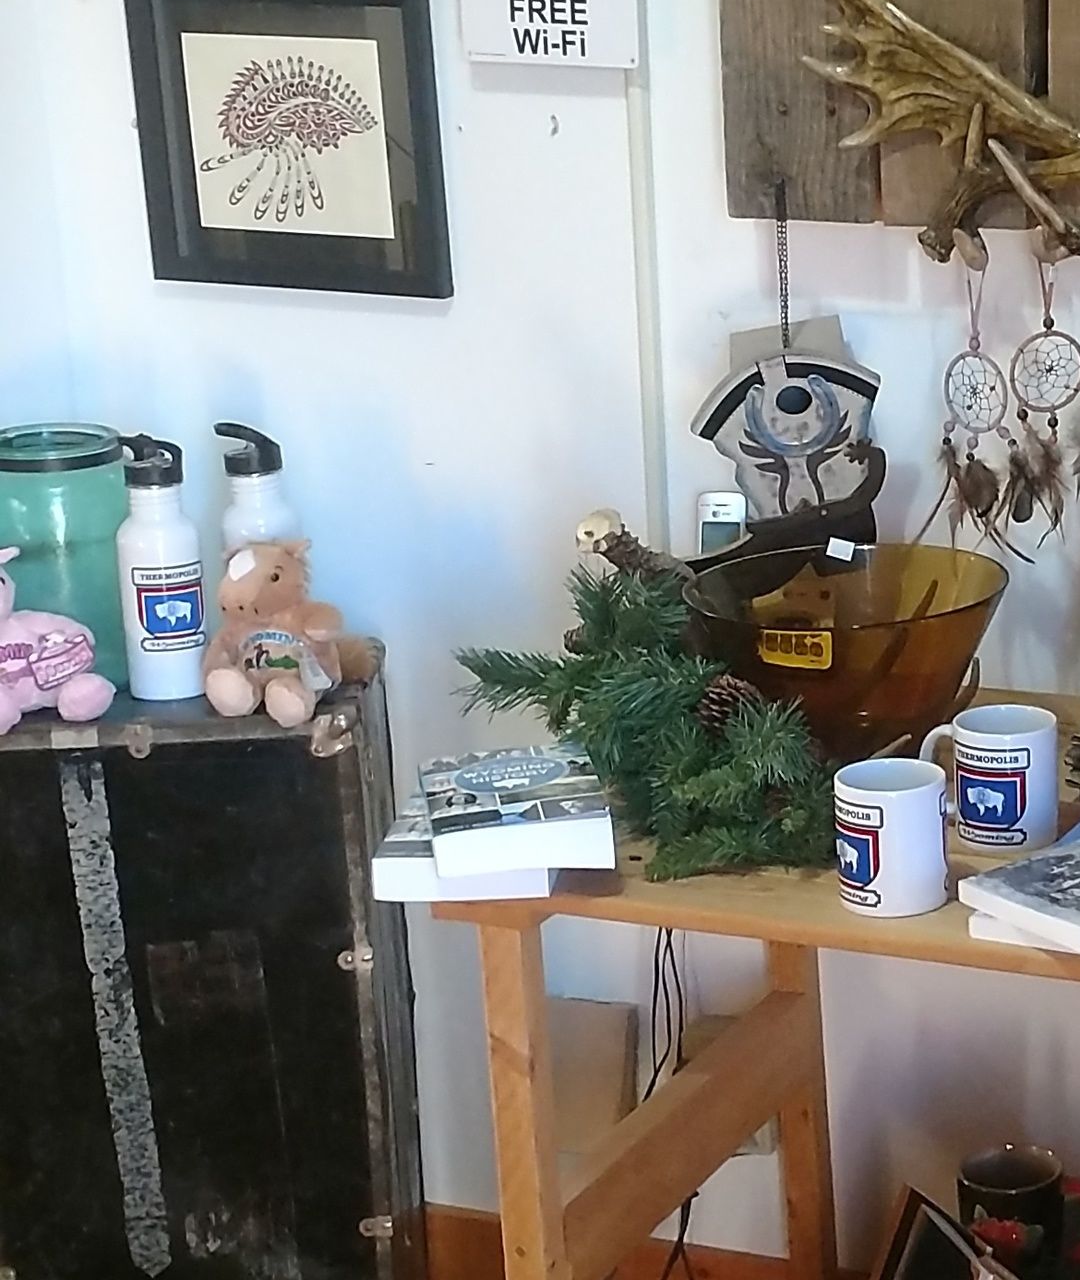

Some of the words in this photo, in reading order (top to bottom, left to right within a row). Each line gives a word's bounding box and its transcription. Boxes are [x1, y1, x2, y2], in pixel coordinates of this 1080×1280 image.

[512, 27, 587, 57] Wi-Fi
[140, 566, 199, 581] THERMOPOLIS
[957, 748, 1019, 765] THERMOPOLIS
[462, 762, 556, 780] WYOMING
[471, 769, 549, 785] HISTORY
[961, 828, 1015, 842] Wyoming
